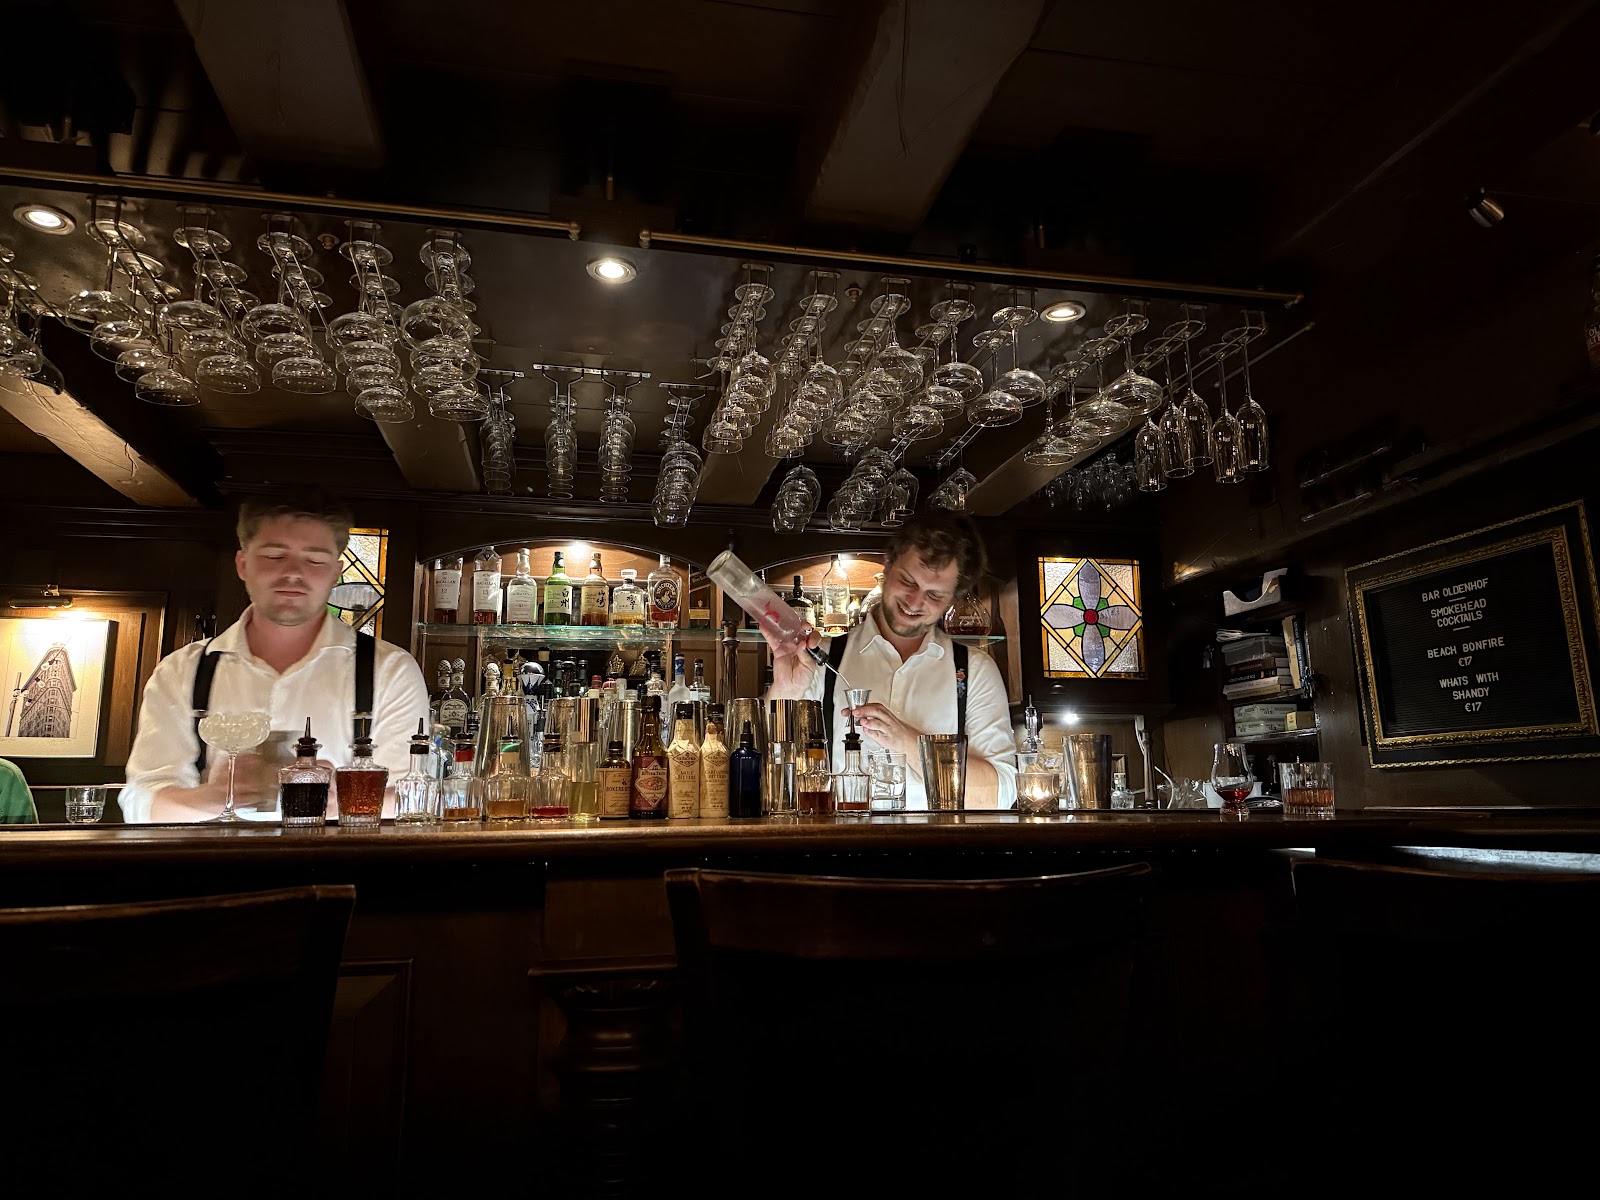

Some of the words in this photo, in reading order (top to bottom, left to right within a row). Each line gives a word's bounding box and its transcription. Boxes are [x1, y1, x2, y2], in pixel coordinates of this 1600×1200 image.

[1422, 590, 1441, 602] BAR
[1443, 578, 1489, 596] OLDENHOF
[1431, 598, 1487, 618] SMOKEHEAD
[1437, 610, 1483, 627] COCKTAILS
[1427, 645, 1457, 659] BEACH
[1462, 636, 1505, 653] BONFIRE
[1458, 656, 1473, 667] €17
[1439, 676, 1469, 689] WHATS
[1475, 672, 1499, 684] WITH
[1452, 687, 1490, 700] SHANDY
[1464, 702, 1482, 712] €17
